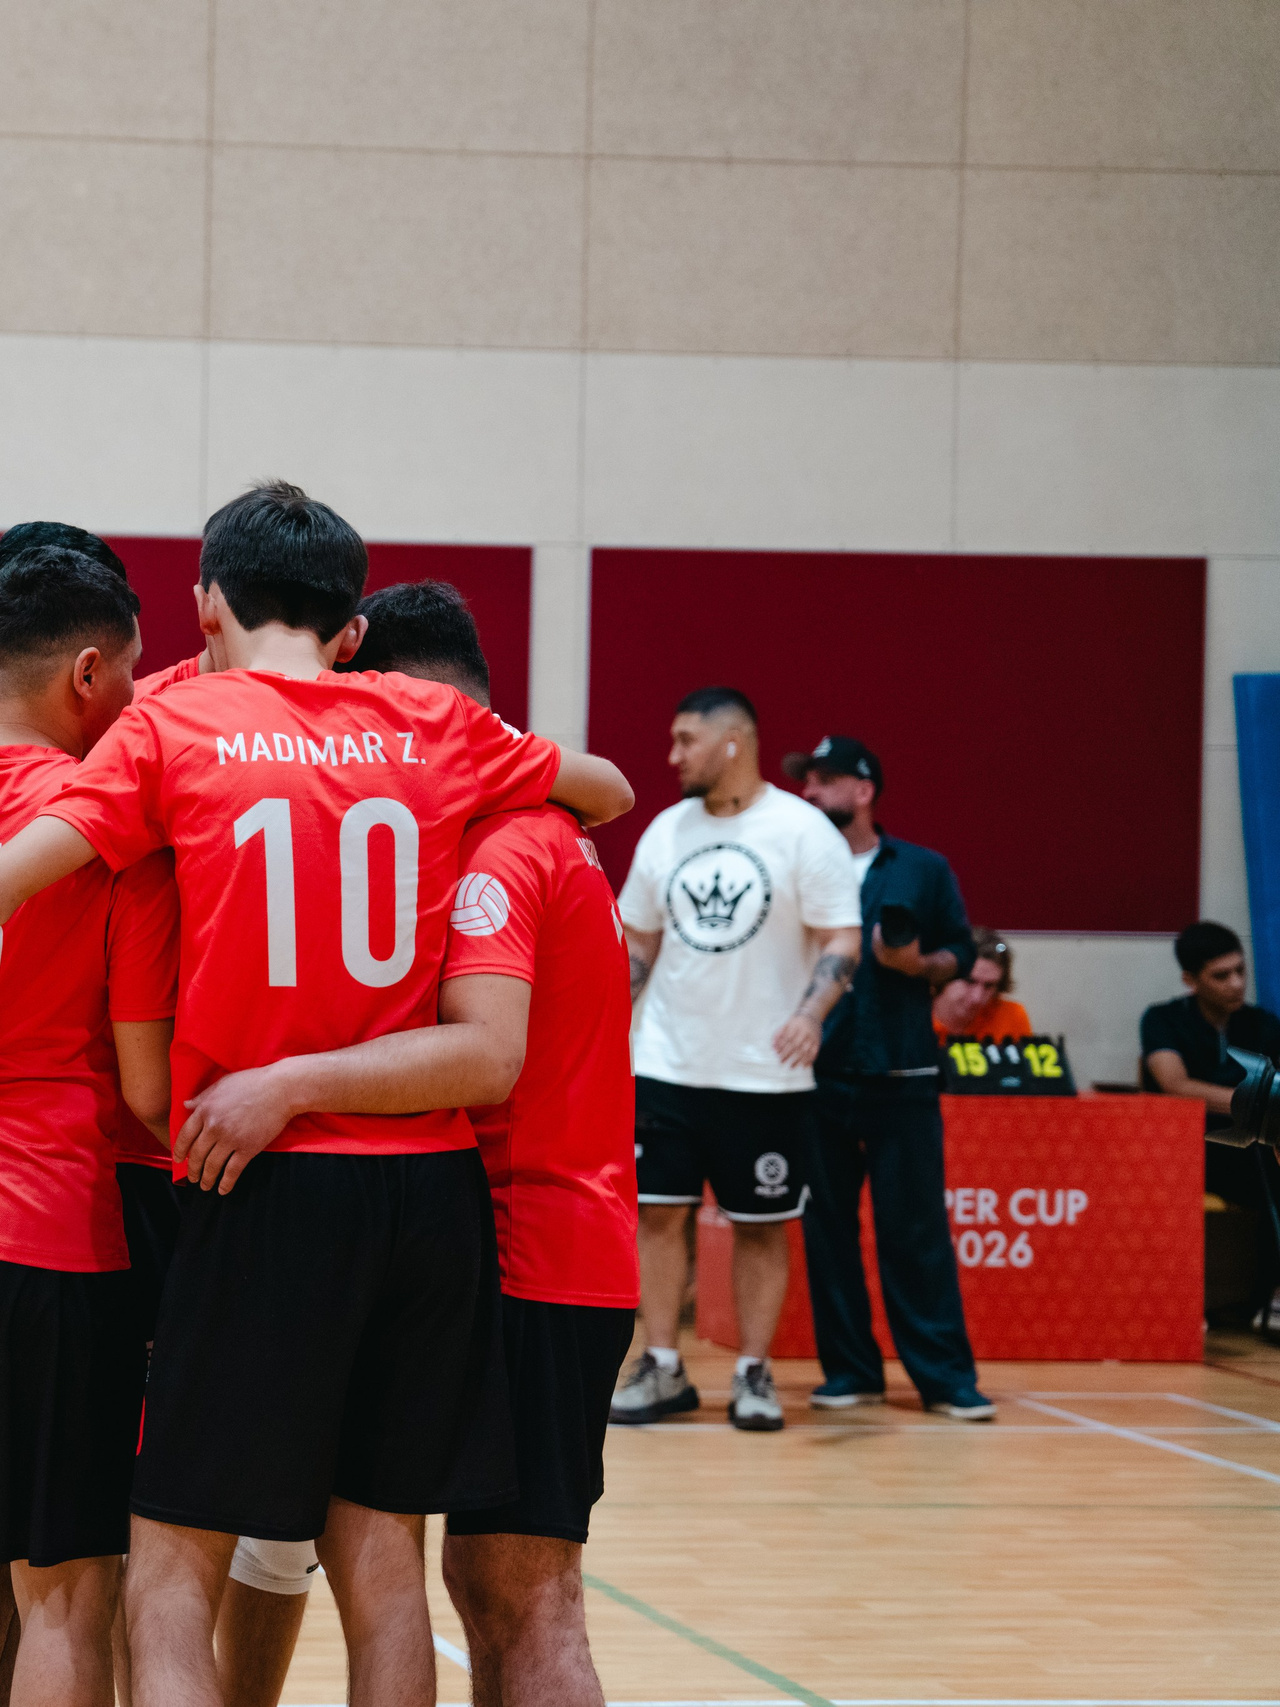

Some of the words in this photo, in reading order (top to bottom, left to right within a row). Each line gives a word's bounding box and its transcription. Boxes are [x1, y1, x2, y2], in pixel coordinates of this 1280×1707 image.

[216, 731, 387, 767] MADIMAR
[396, 731, 426, 765] Z.
[233, 796, 419, 988] 10
[948, 1042, 988, 1077] 15
[1023, 1044, 1063, 1077] 12
[1009, 1187, 1088, 1226] CUP
[953, 1229, 1034, 1268] 026
